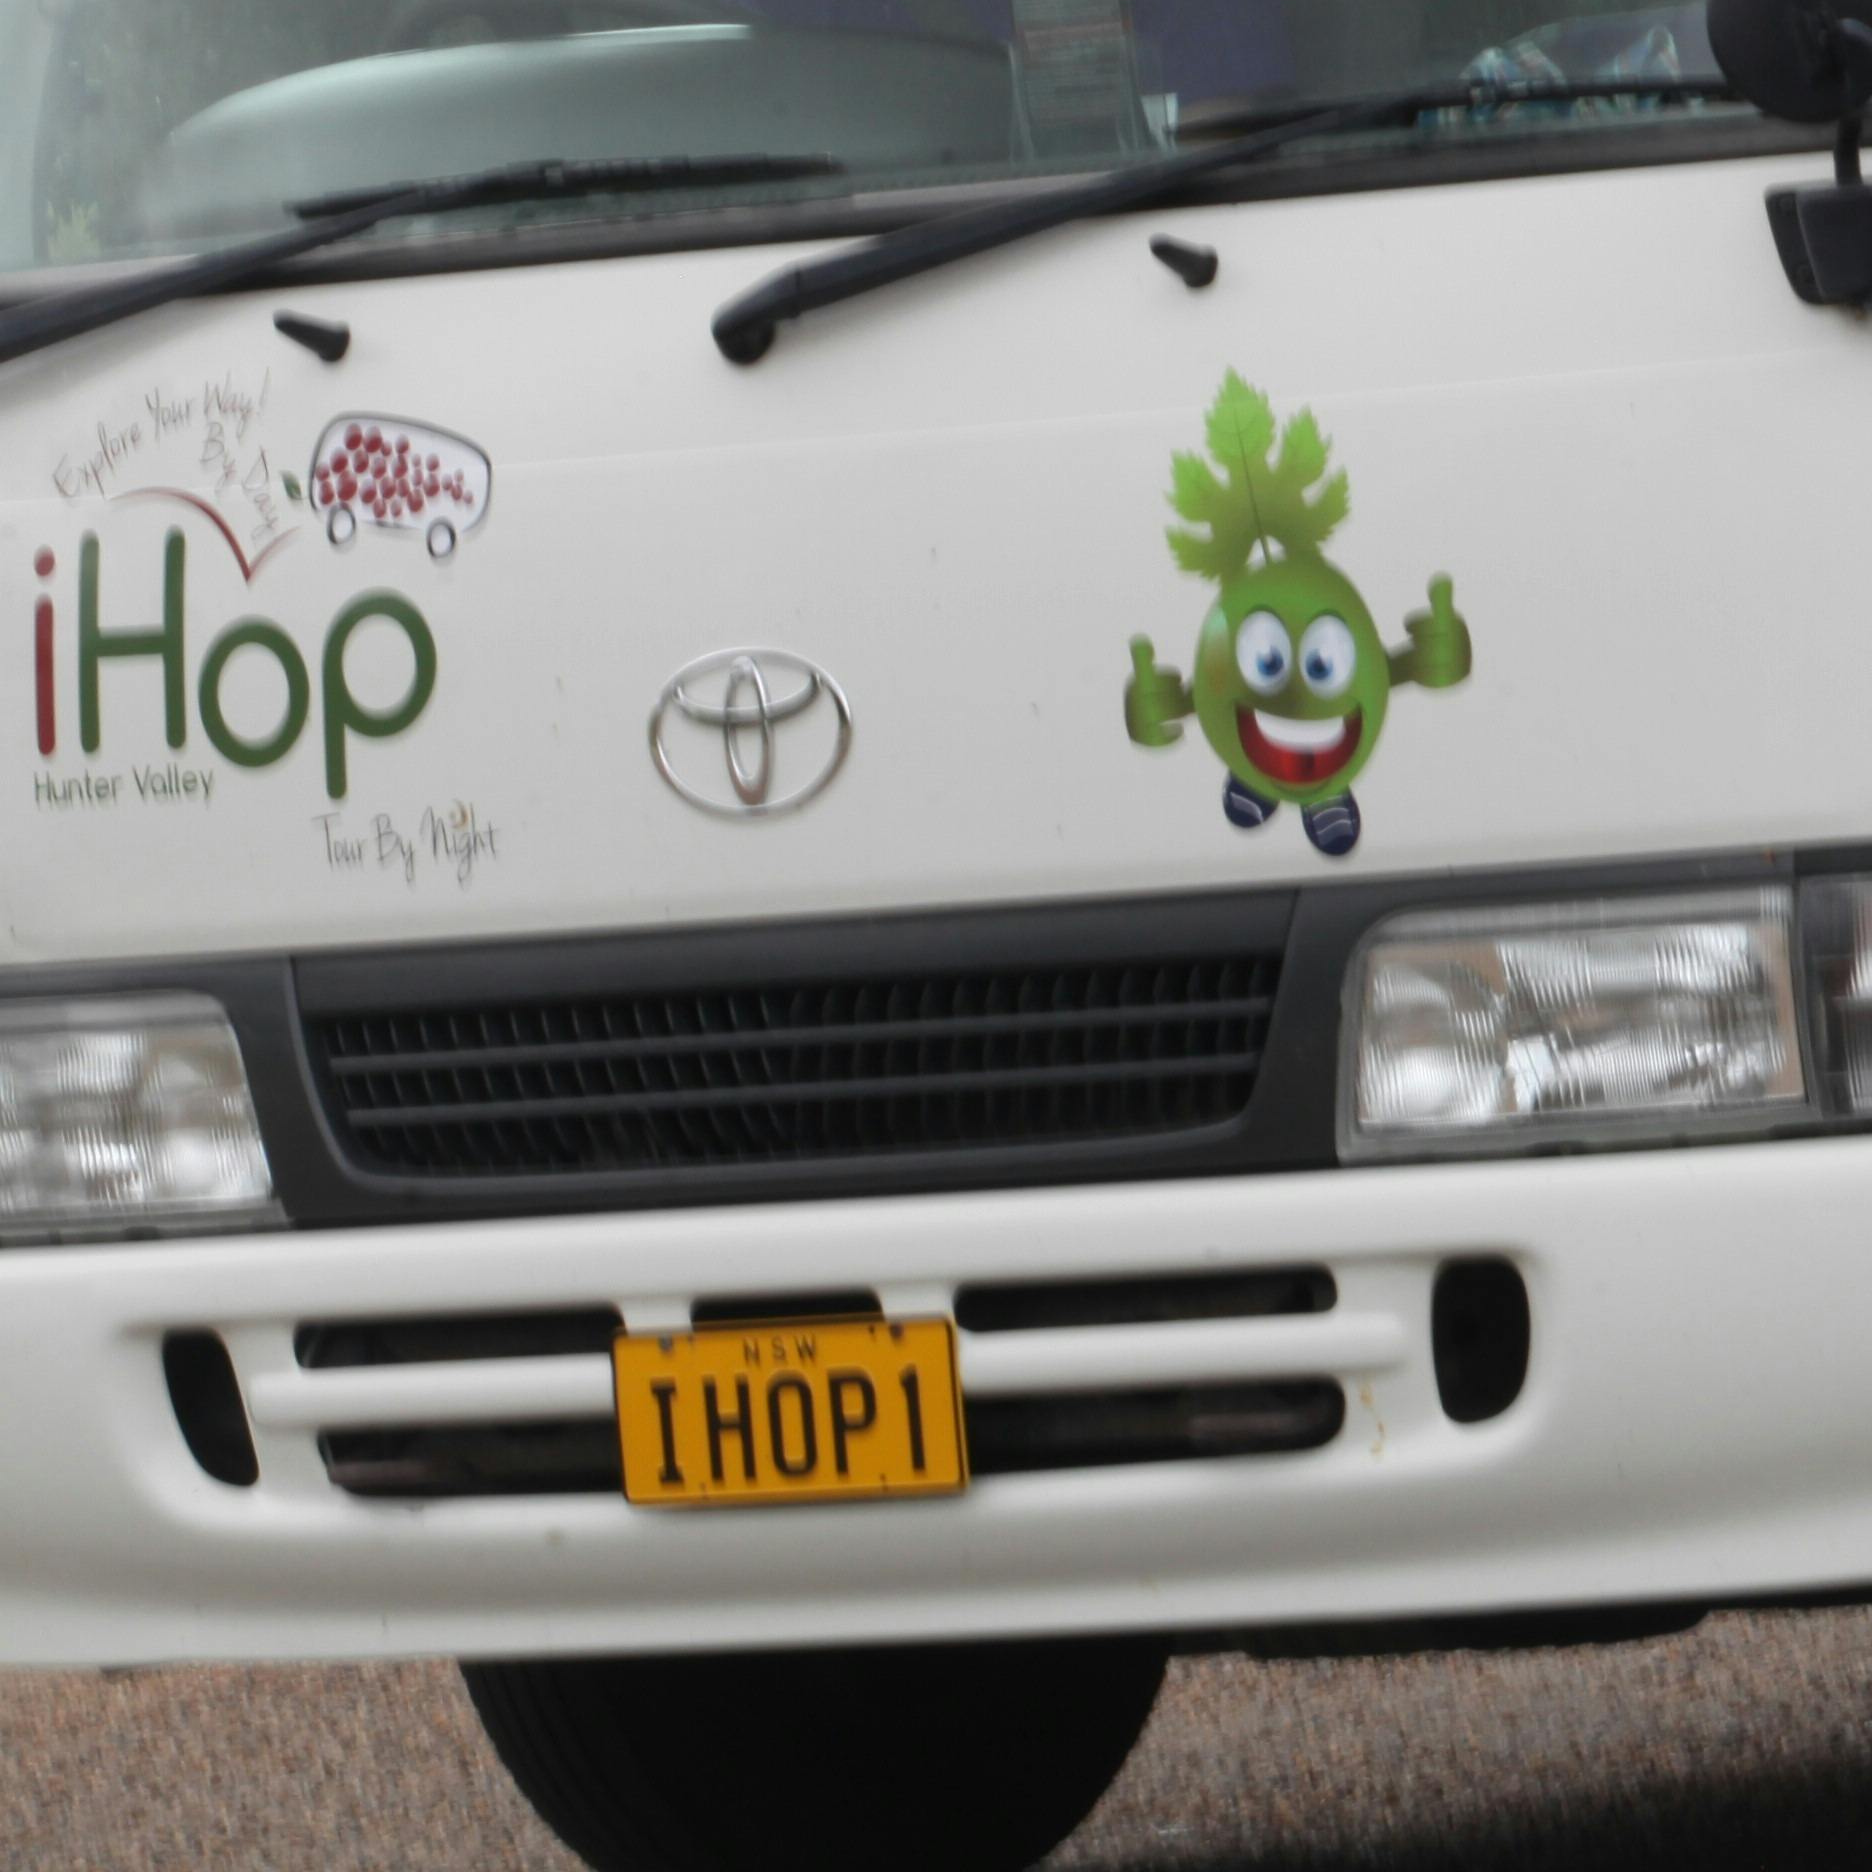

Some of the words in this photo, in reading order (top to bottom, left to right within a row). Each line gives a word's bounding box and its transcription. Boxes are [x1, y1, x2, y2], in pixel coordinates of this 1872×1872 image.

[52, 422, 142, 499] Explore
[144, 386, 193, 443] Your
[202, 366, 271, 437] Way!
[199, 421, 235, 492] By
[33, 525, 438, 802] iHop
[34, 770, 123, 809] Hunter
[132, 763, 215, 804] Valley
[311, 811, 367, 870] Tour
[374, 813, 417, 884] By
[418, 799, 501, 885] Night
[743, 1334, 819, 1368] NSW
[650, 1362, 927, 1485] IHOP1
